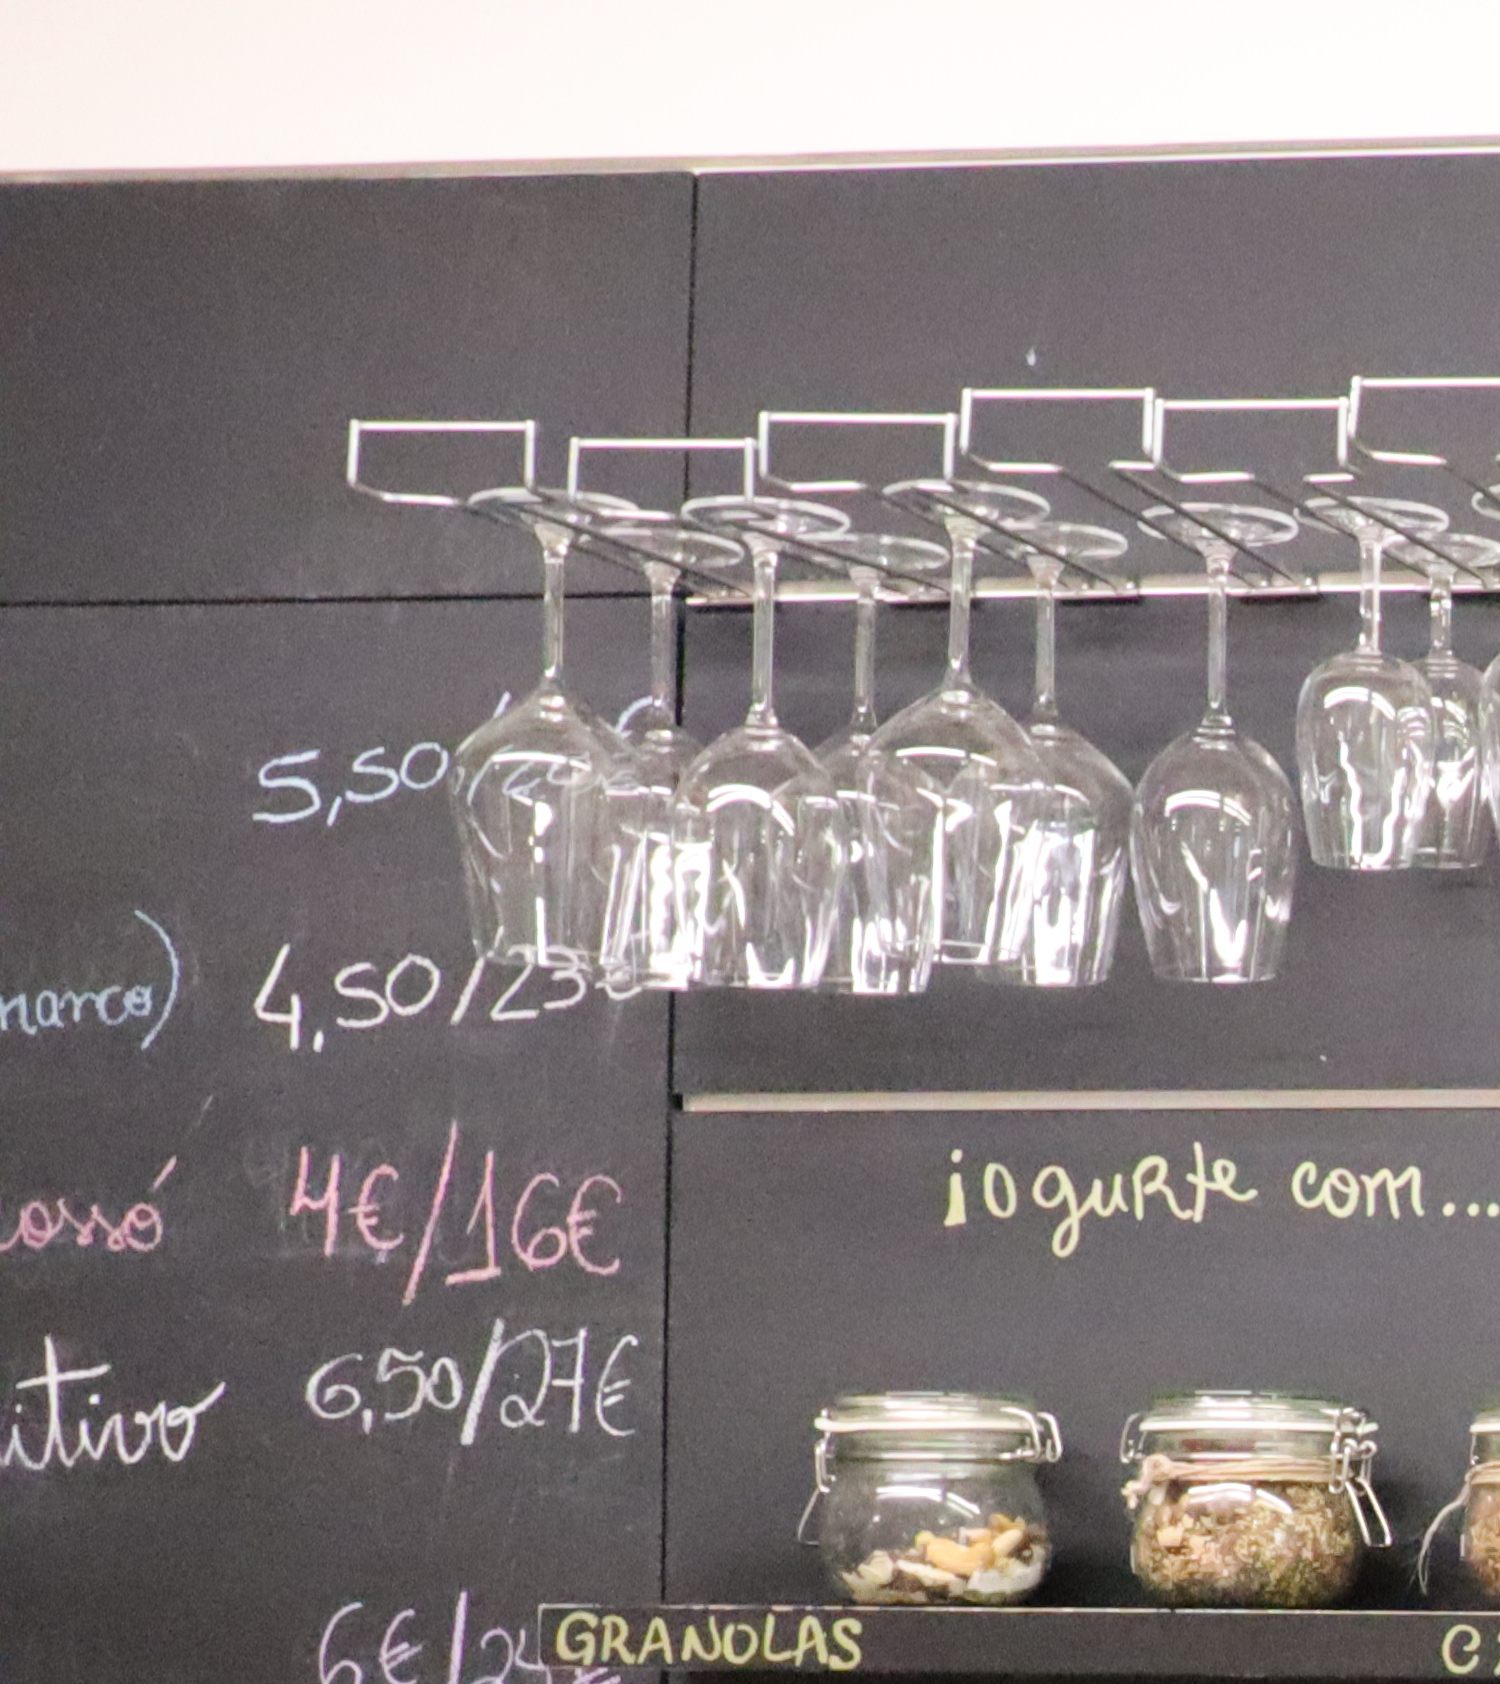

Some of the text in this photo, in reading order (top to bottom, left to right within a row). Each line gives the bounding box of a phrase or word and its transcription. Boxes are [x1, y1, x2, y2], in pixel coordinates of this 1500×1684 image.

[288, 1118, 622, 1305] 4€/16€
[305, 1318, 640, 1446] 6,50/27€
[556, 1610, 862, 1672] GRANOLAS
